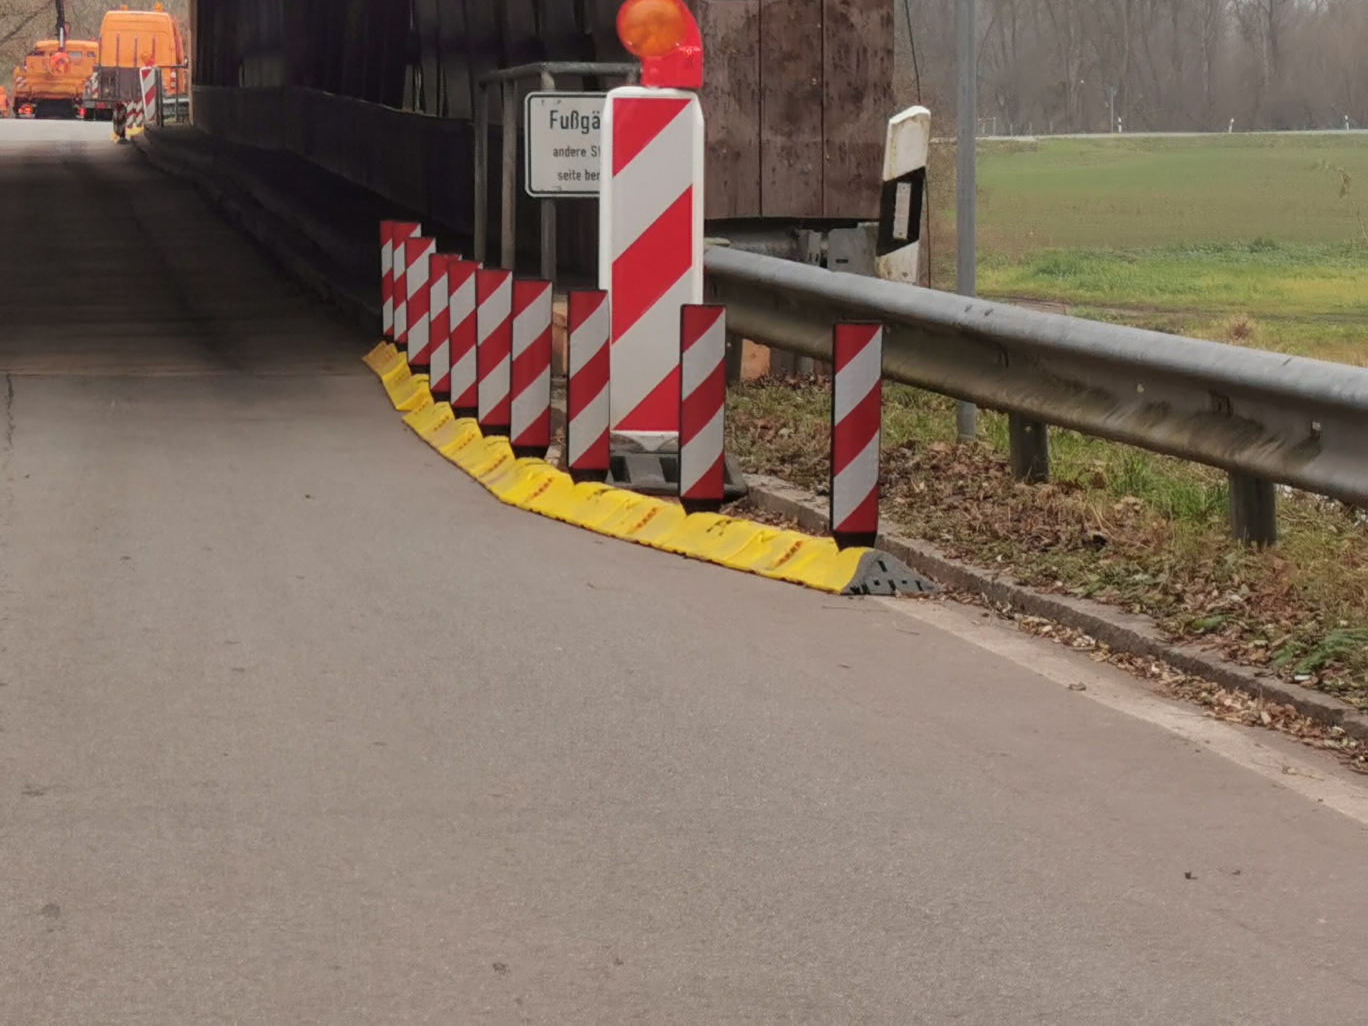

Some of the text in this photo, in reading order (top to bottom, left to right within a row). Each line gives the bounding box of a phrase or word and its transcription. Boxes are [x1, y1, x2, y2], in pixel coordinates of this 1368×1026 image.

[549, 110, 600, 135] Fußgä
[553, 145, 587, 157] andere
[557, 169, 582, 181] seite
